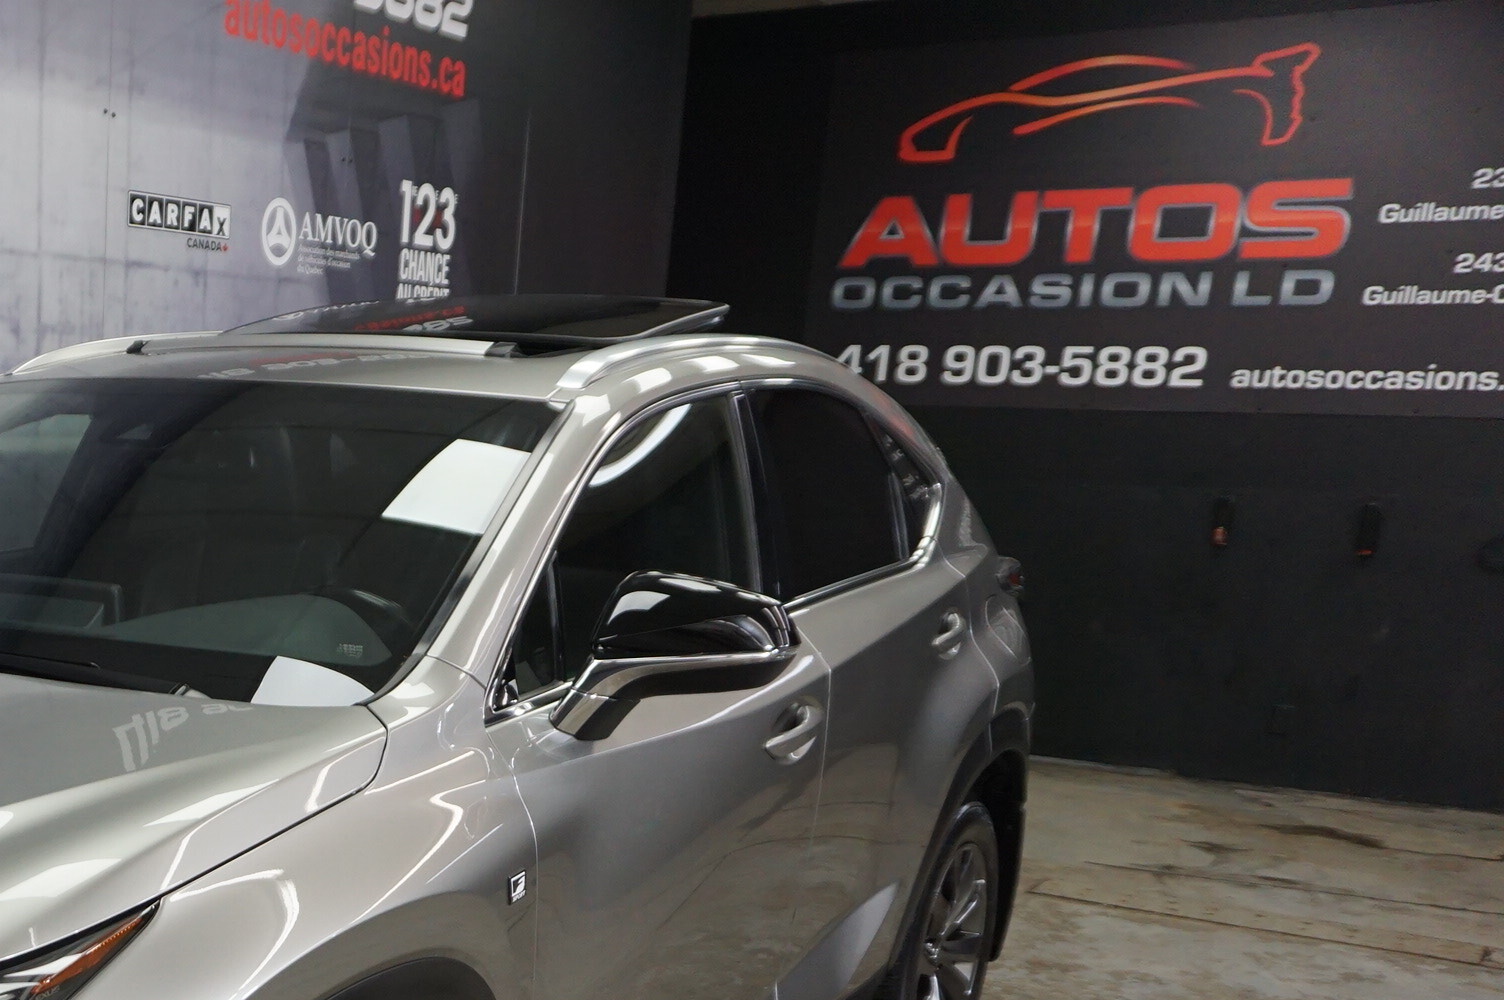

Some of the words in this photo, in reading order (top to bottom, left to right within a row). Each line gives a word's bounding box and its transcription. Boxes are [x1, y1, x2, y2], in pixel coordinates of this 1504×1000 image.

[224, 0, 466, 97] autosoccasions.ca
[130, 195, 229, 238] CARFAX
[298, 212, 377, 257] AMVOQ
[838, 177, 1353, 269] AUTOS
[1378, 202, 1504, 224] Guillaume
[186, 238, 223, 251] CANADA
[399, 248, 451, 285] CHANCE
[831, 271, 1212, 309] OCCASION
[1230, 269, 1336, 307] LD
[837, 344, 929, 383] 418
[942, 345, 1208, 388] 903-5882
